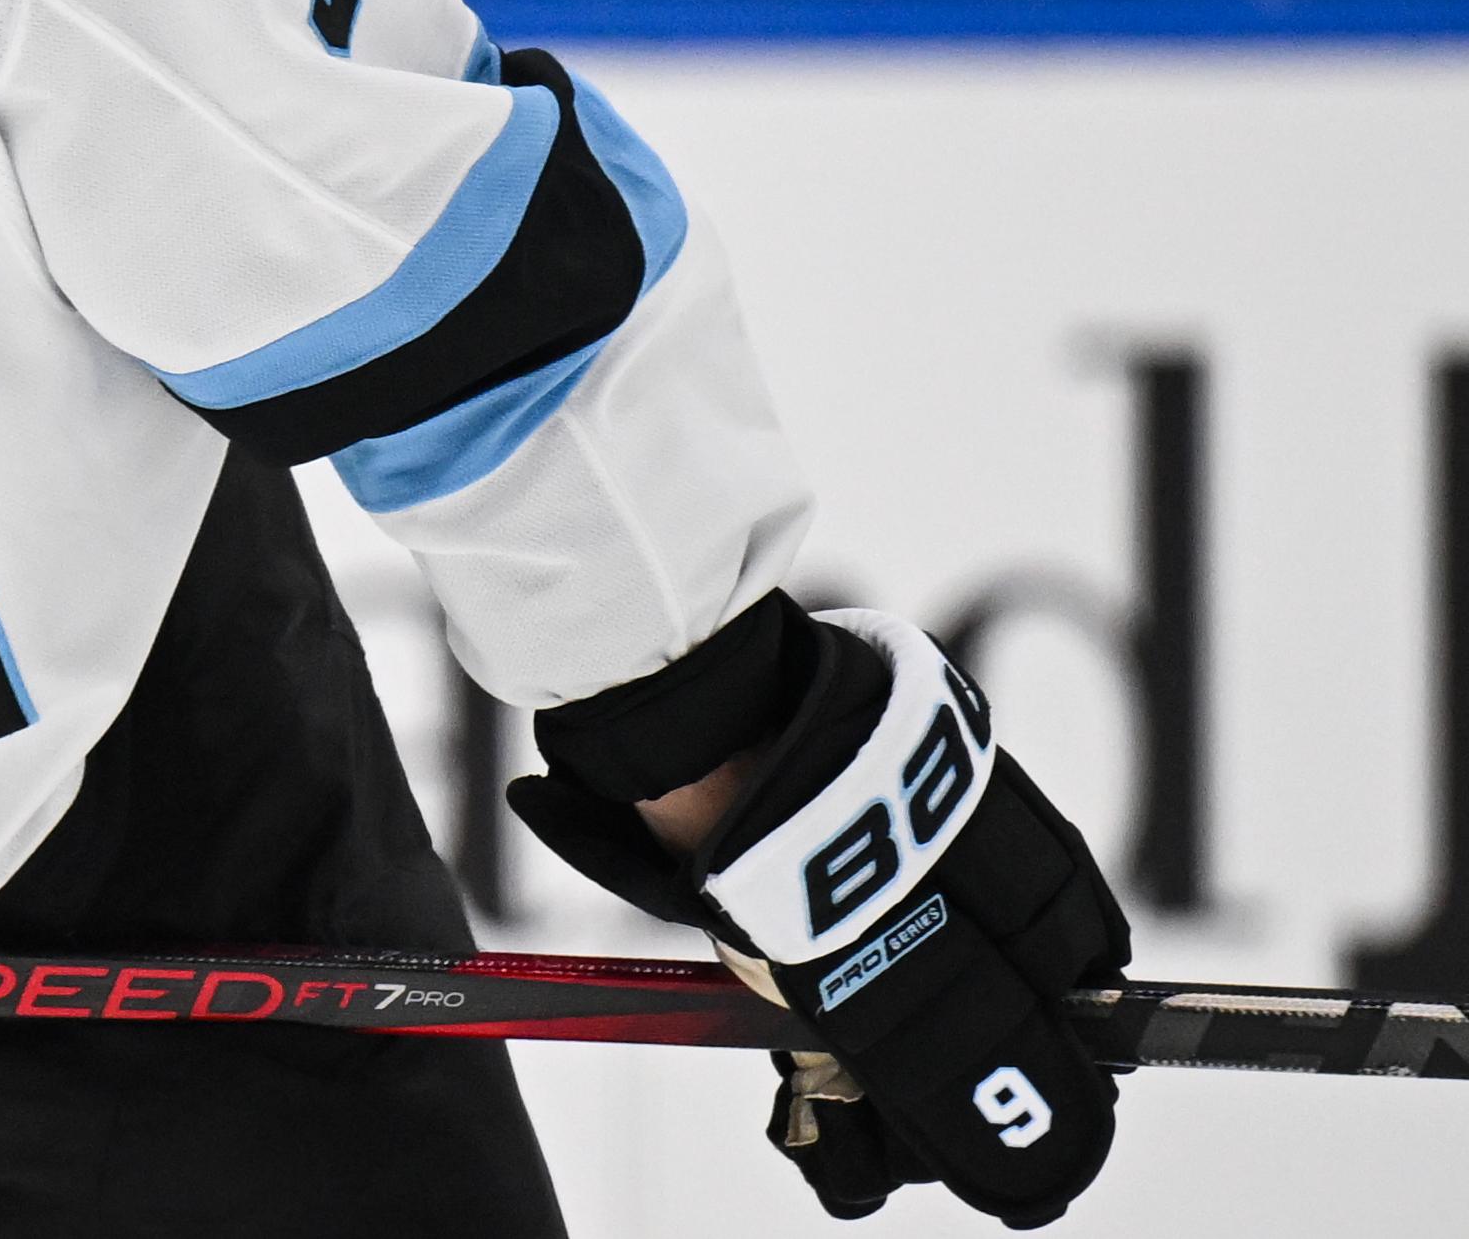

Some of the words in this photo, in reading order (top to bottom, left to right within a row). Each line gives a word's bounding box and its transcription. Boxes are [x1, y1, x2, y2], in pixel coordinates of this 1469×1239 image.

[825, 948, 882, 1000] PRO
[888, 907, 941, 951] SERIES
[972, 1065, 1054, 1149] 9
